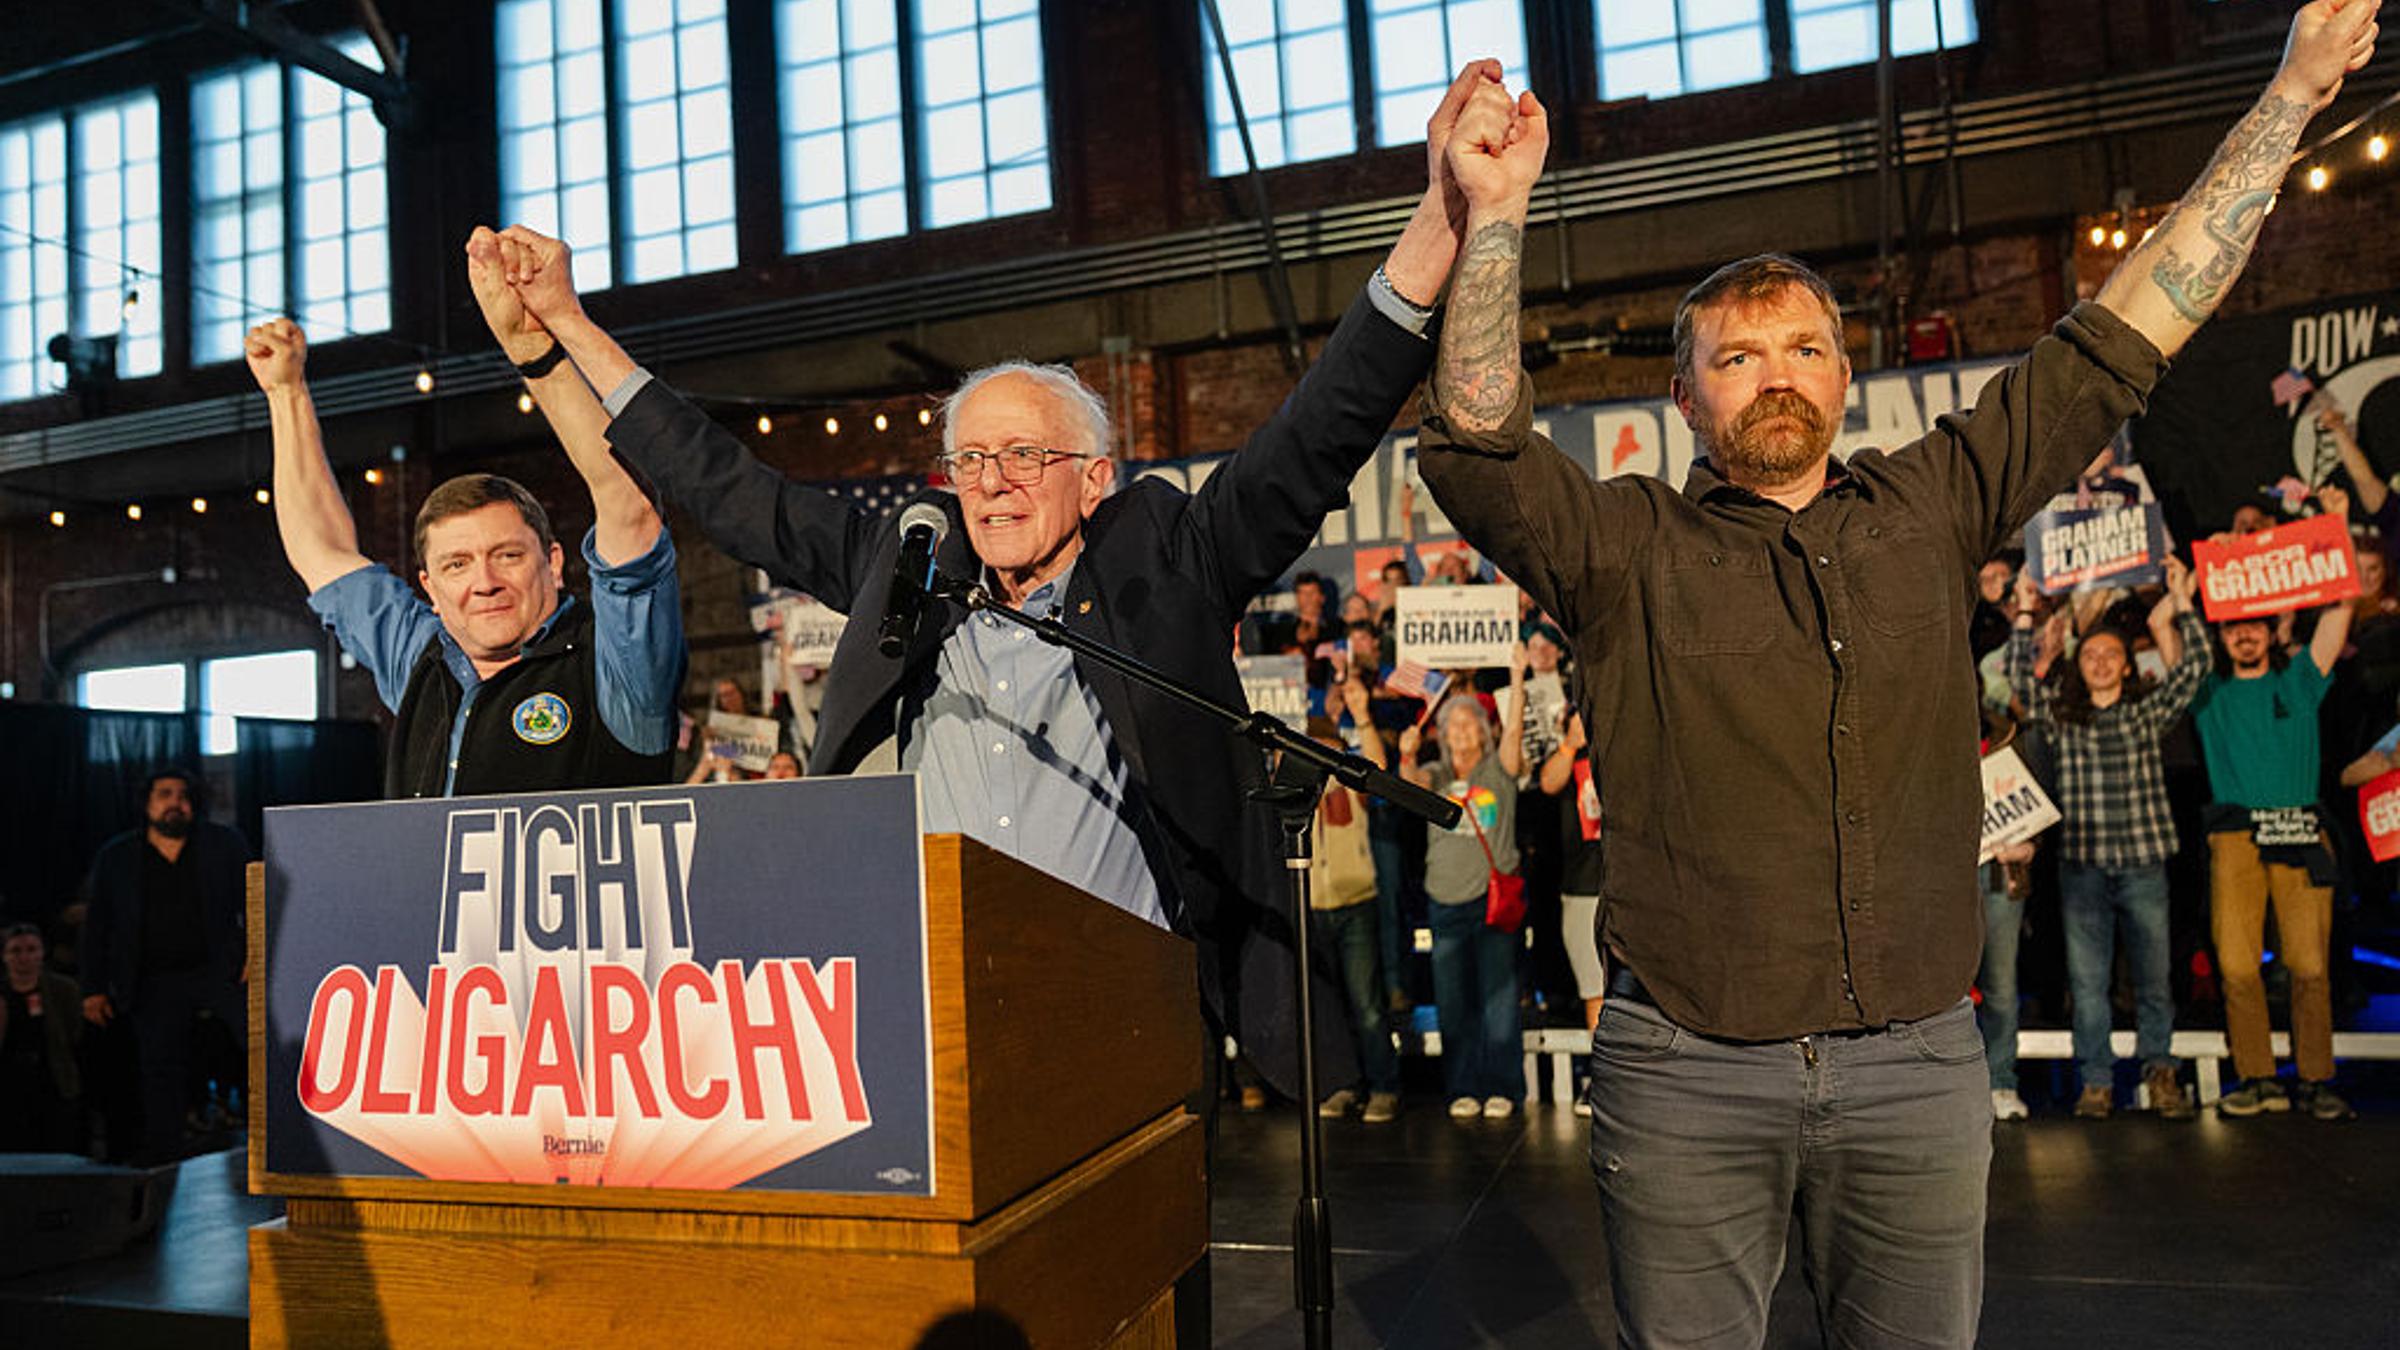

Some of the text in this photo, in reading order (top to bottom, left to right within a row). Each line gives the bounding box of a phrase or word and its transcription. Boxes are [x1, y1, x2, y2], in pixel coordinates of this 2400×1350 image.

[2290, 304, 2378, 390] POW
[2042, 505, 2146, 553] GRAHAM
[2043, 530, 2149, 577] PLATNER
[2207, 548, 2349, 602] GRAHAM
[1404, 620, 1513, 645] GRAHAM
[1983, 785, 2042, 834] HAM
[439, 799, 696, 955] FIGHT
[298, 957, 872, 1125] OLIGARCHY
[543, 1134, 605, 1155] Bernie
